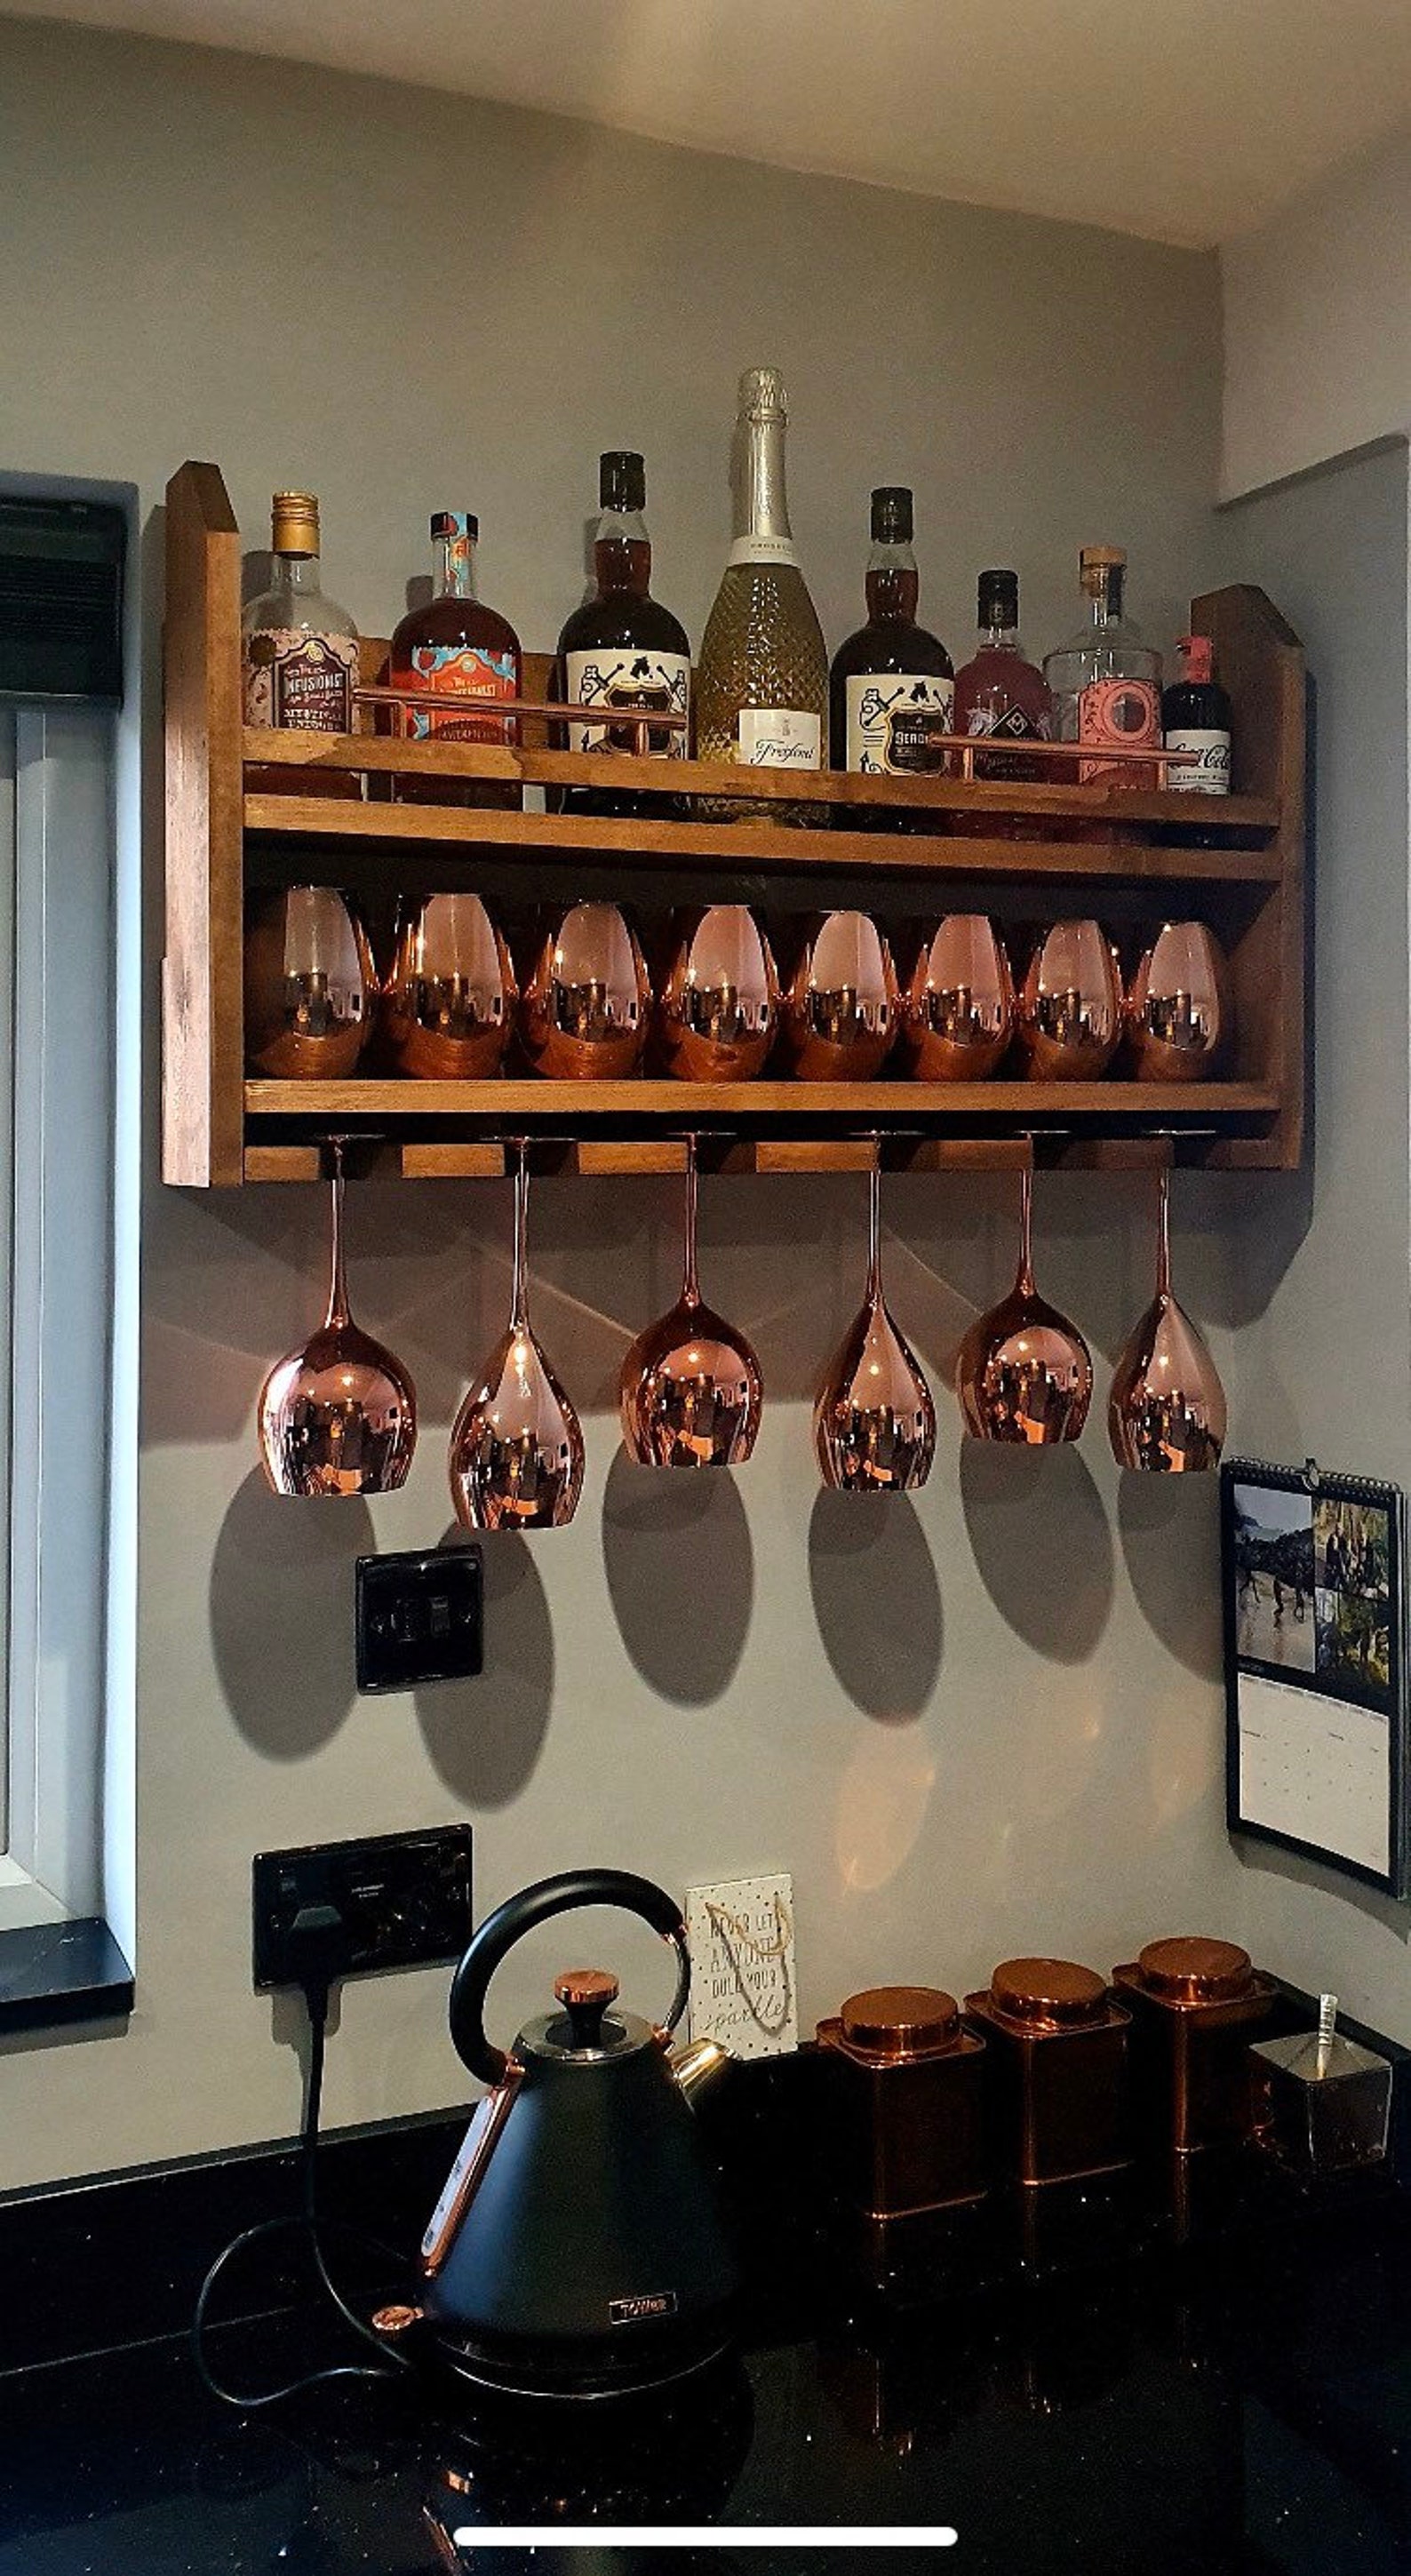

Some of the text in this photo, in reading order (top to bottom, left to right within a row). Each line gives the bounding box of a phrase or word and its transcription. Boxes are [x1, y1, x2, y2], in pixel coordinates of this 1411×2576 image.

[895, 731, 929, 746] SEAD
[710, 1913, 773, 1939] NEVER LET
[710, 1936, 775, 1974] ANYONE
[712, 1968, 777, 1999] DULL YOUR
